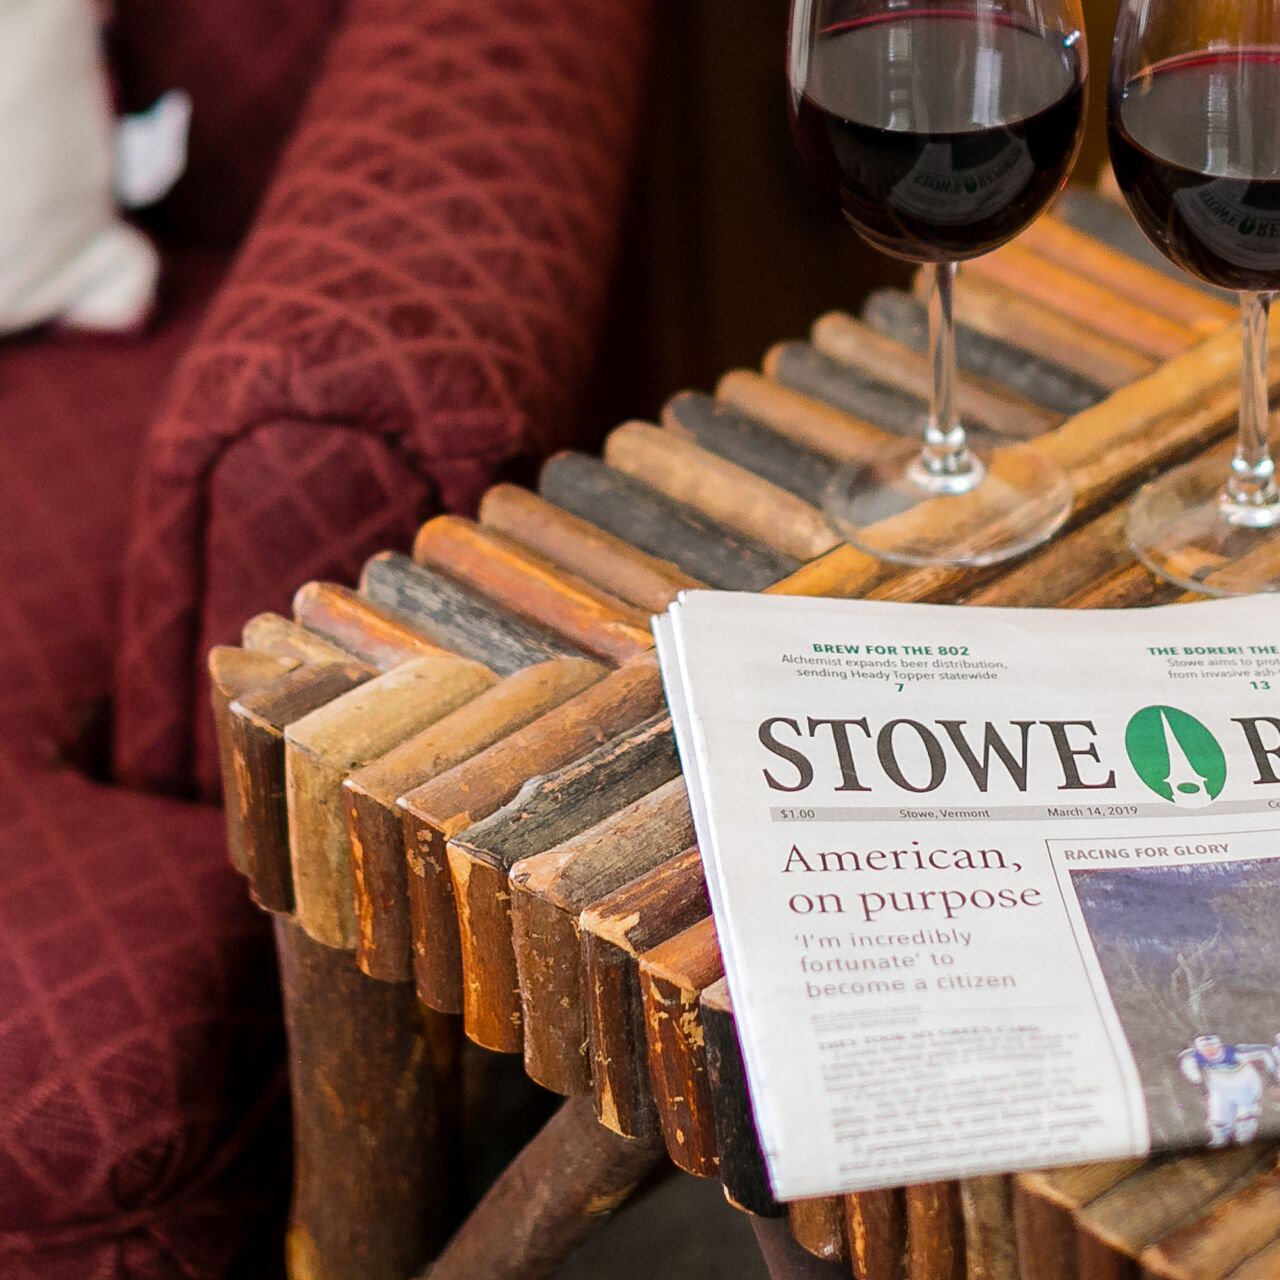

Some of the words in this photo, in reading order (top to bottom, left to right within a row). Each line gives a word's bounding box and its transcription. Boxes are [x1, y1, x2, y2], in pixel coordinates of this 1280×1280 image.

[812, 643, 860, 655] BREW
[865, 645, 898, 655] FOR
[902, 646, 933, 656] THE
[938, 646, 970, 656] 802
[1147, 646, 1179, 656] THE
[1183, 646, 1244, 656] BORER!
[1248, 645, 1279, 655] THE
[781, 653, 842, 667] Alchemist
[846, 658, 897, 669] expands
[900, 658, 928, 669] beer
[1167, 657, 1205, 668] Stowe
[1208, 657, 1237, 667] aims
[1240, 657, 1253, 667] to
[796, 668, 848, 680] sending
[851, 669, 890, 681] Heady
[894, 670, 936, 681] Topper
[938, 671, 999, 681] statewide
[1168, 669, 1198, 679] from
[1201, 668, 1251, 679] invasive
[895, 682, 905, 693] 7
[1249, 680, 1271, 691] 13
[757, 716, 1117, 793] STOWE
[780, 808, 815, 819] $1.00
[899, 808, 938, 820] Stowe,
[939, 808, 991, 819] Vermont
[1047, 806, 1084, 818] March
[781, 841, 1022, 873] American,
[1063, 848, 1130, 861] RACING
[1134, 846, 1169, 858] FOR
[1174, 843, 1230, 856] GLORY
[788, 891, 846, 914] on
[858, 887, 1043, 922] purpose
[850, 927, 972, 947] incredibly
[931, 952, 954, 967] to
[806, 979, 906, 999] become
[915, 978, 927, 991] a
[937, 972, 1017, 991] citizen
